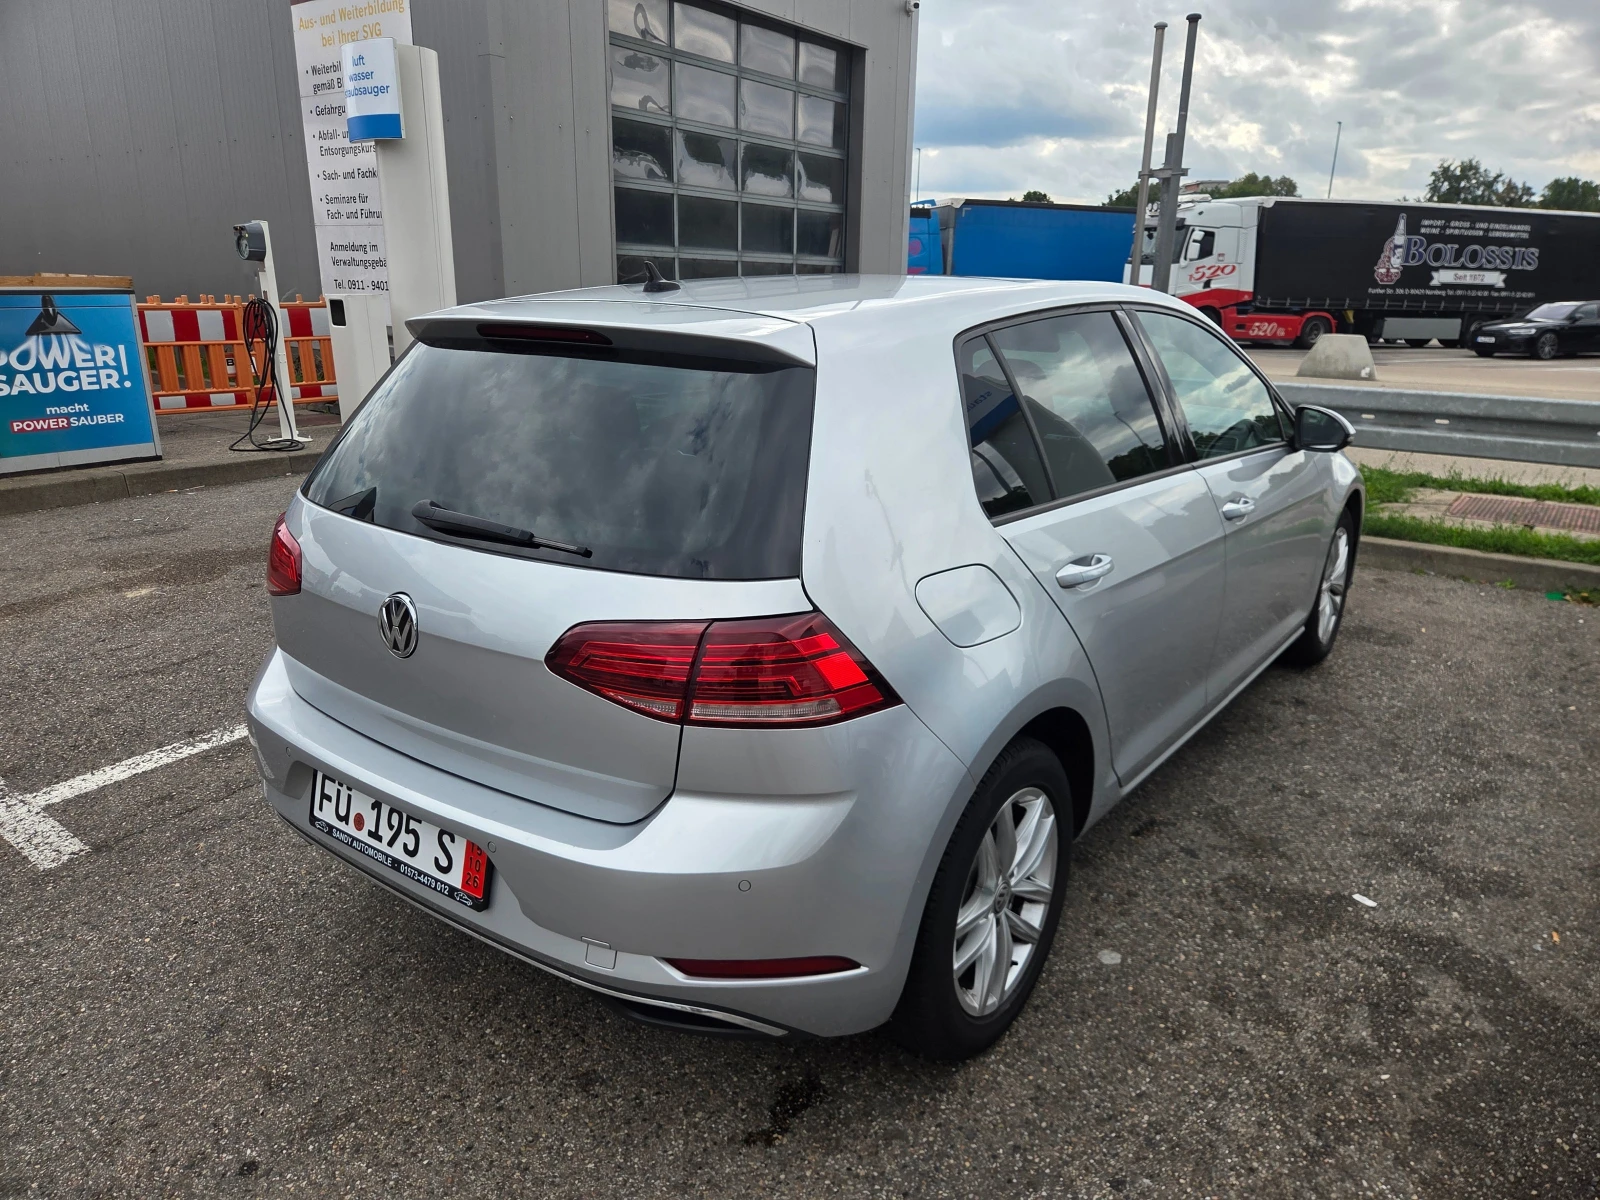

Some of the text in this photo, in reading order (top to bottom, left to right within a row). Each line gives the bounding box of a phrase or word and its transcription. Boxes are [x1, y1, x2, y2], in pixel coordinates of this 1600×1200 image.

[299, 0, 405, 31] Aus- und Weiterbildung
[321, 22, 382, 47] bei Ihrer SVG
[352, 54, 365, 67] luft
[349, 71, 374, 82] wasser
[313, 78, 335, 95] gemäß
[318, 128, 340, 141] Abfall-
[322, 167, 378, 181] Sach- und Fachk
[325, 192, 368, 204] Seminare für
[327, 209, 344, 220] Fach-
[346, 208, 358, 219] und
[330, 241, 379, 255] Anmeldung im
[1401, 235, 1539, 271] BOLOSSIS
[334, 279, 346, 289] Tel.
[347, 279, 365, 290] 0911
[371, 280, 389, 291] 9401
[1249, 322, 1277, 336] 520
[46, 403, 90, 415] macht
[13, 413, 124, 432] POWER SAUBER
[319, 774, 455, 874] FÜ 195 S
[332, 828, 352, 847] SANDY
[353, 840, 393, 867] AUTOMOBILE
[400, 864, 435, 888] 01573-4479
[437, 883, 449, 895] 012
[469, 856, 481, 872] 10
[465, 871, 479, 888] 26
